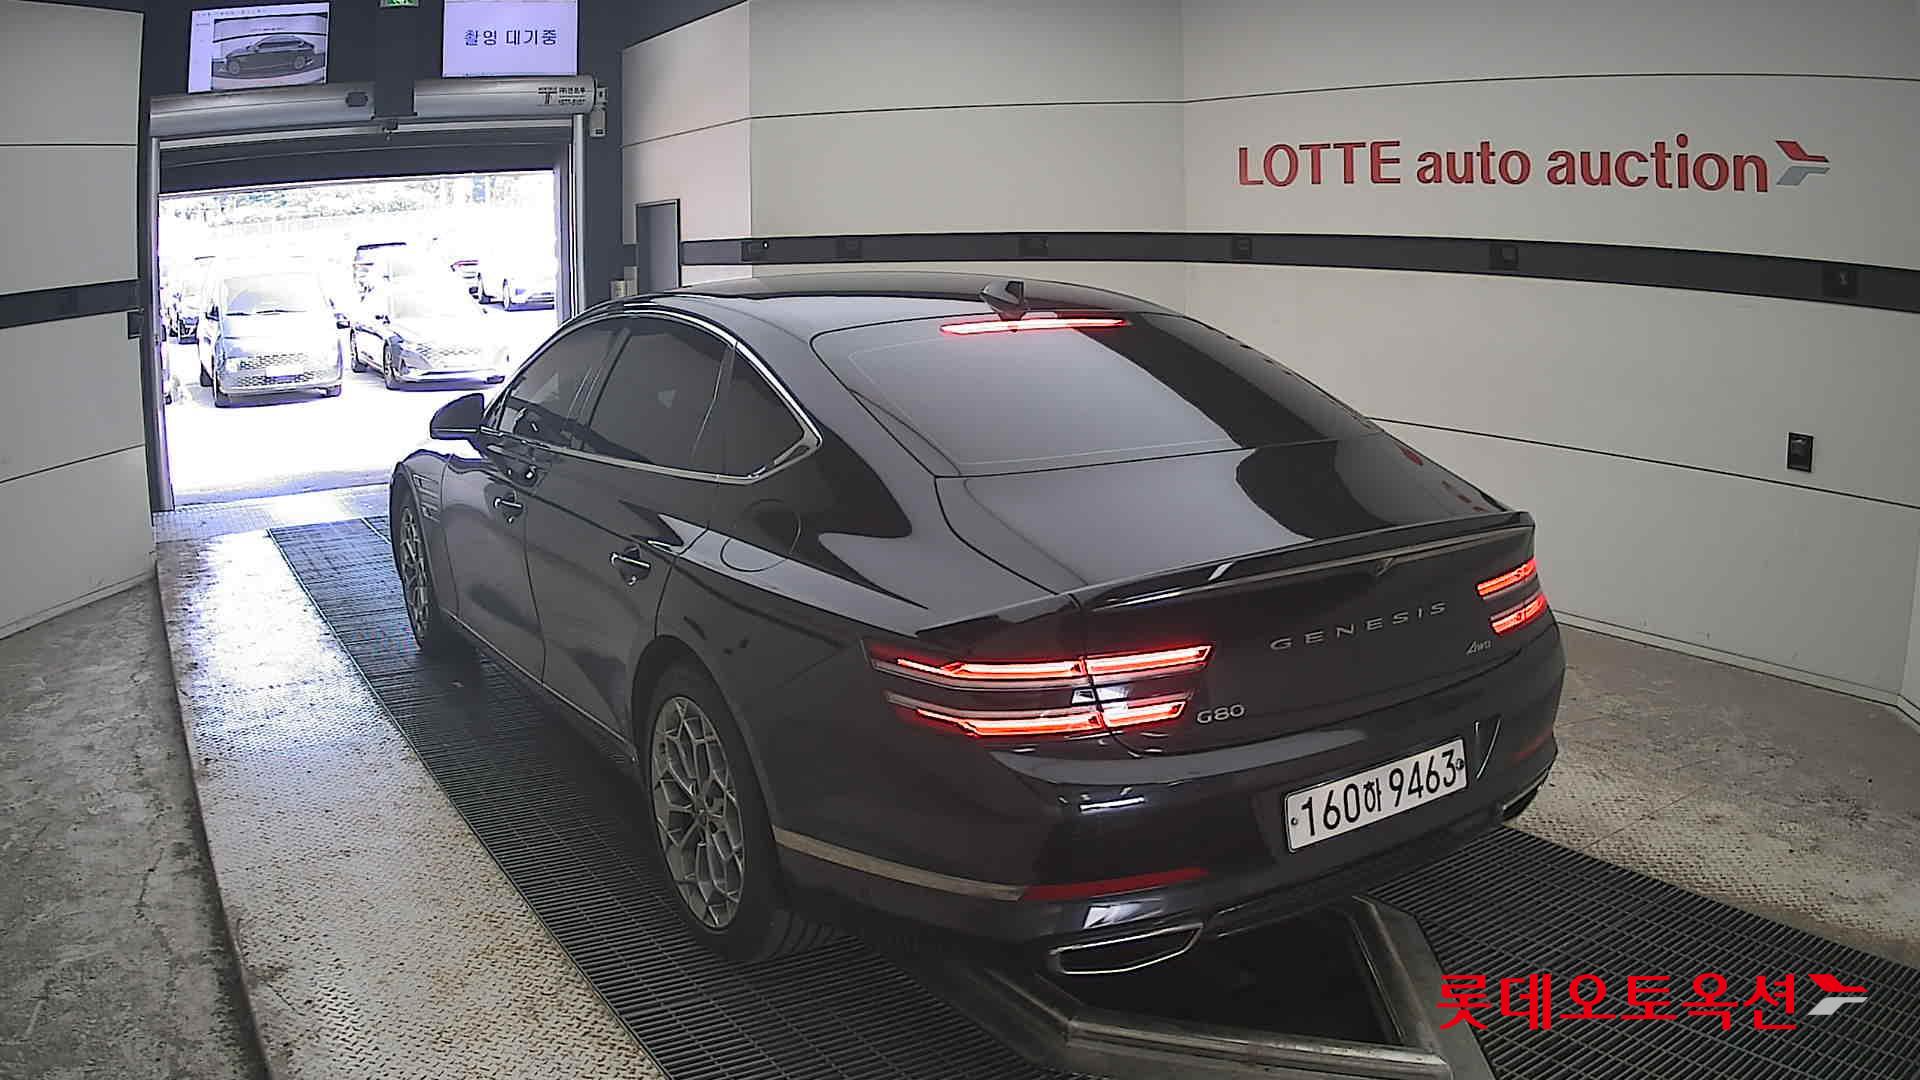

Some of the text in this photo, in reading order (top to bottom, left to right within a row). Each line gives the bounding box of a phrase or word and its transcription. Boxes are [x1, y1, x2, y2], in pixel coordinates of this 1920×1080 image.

[464, 29, 556, 46] 촬영 대기중
[1239, 134, 1769, 193] LOTTE auto auction
[1269, 601, 1448, 651] GENESIS
[1196, 703, 1246, 725] G80
[1301, 750, 1458, 837] 160하 9463
